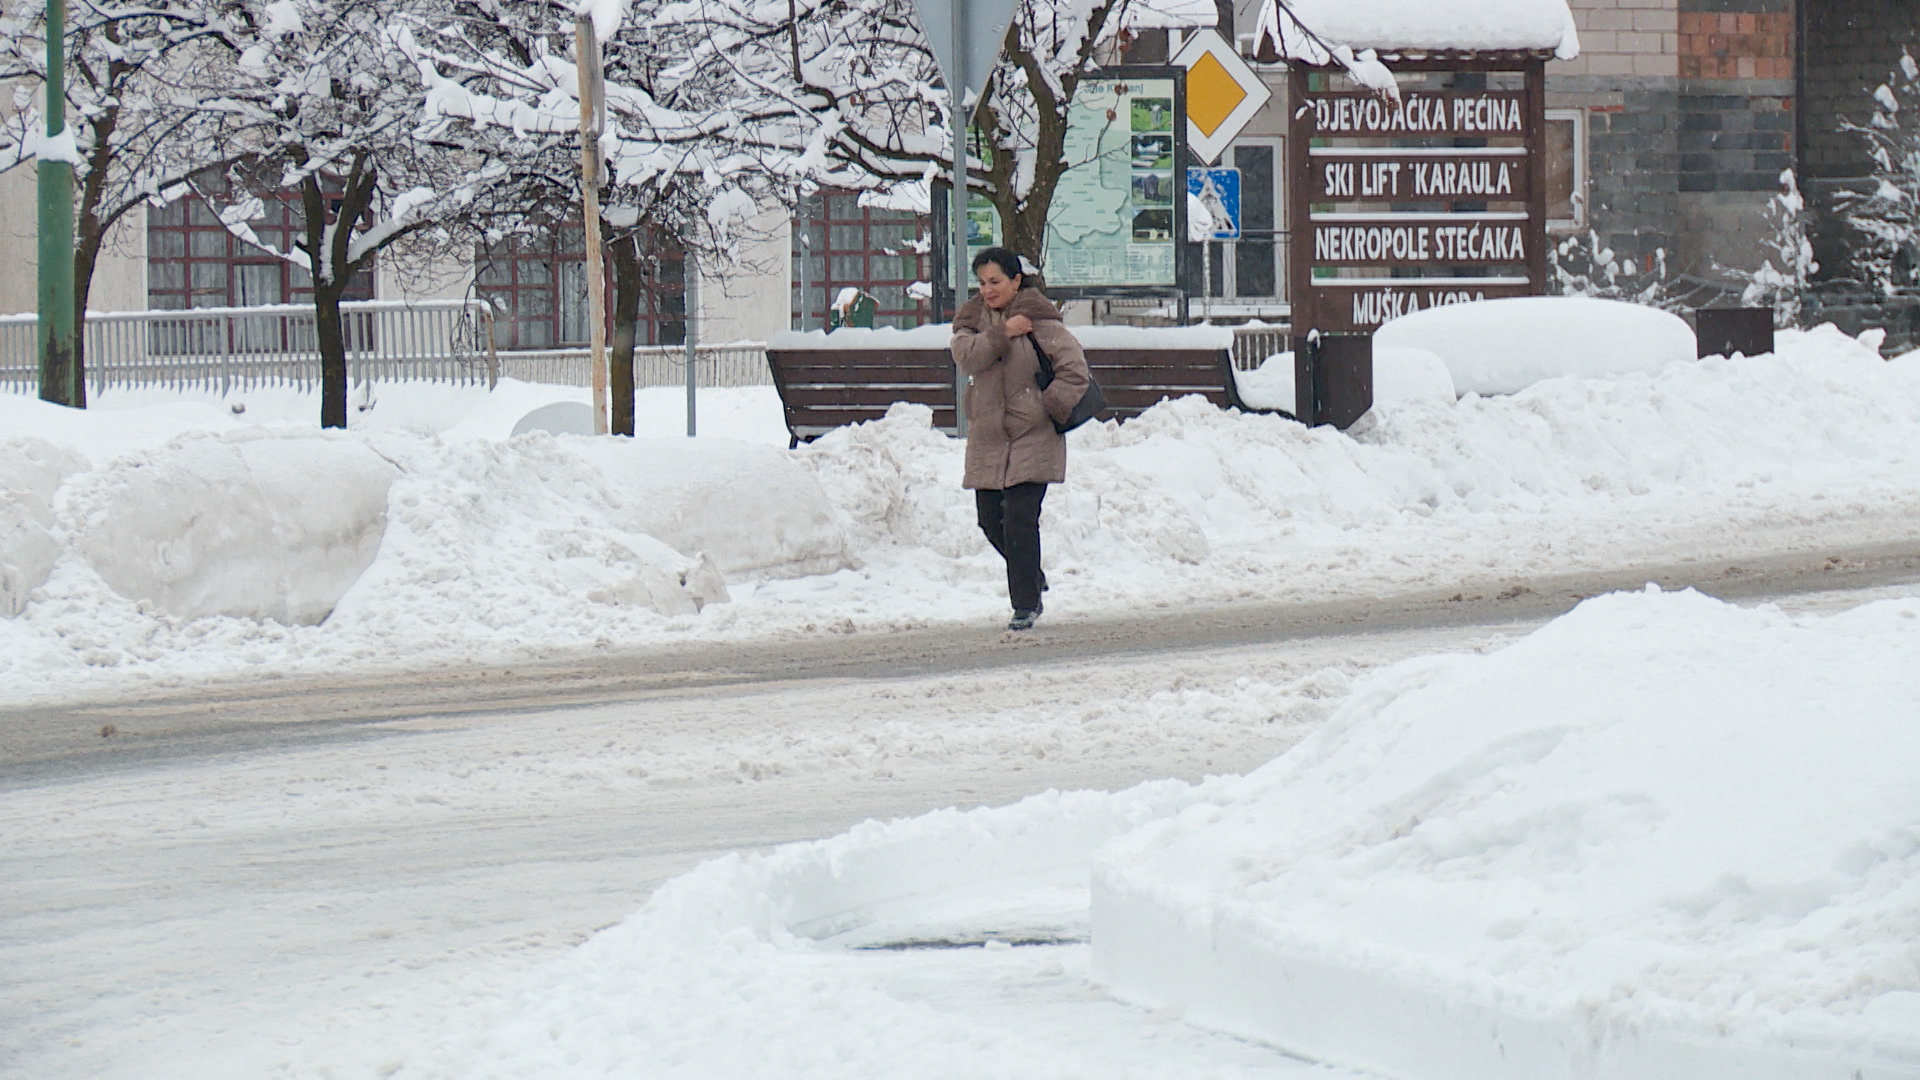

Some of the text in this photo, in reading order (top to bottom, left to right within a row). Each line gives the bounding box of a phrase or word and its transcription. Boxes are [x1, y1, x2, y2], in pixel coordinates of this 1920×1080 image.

[1315, 93, 1522, 132] DJEVOJAČKA PEĆINA
[1325, 162, 1354, 196] SKI
[1361, 162, 1401, 196] LIFT
[1315, 222, 1525, 260] NEKROPOLE STEĆAKA
[1353, 287, 1420, 325] MUŠKA
